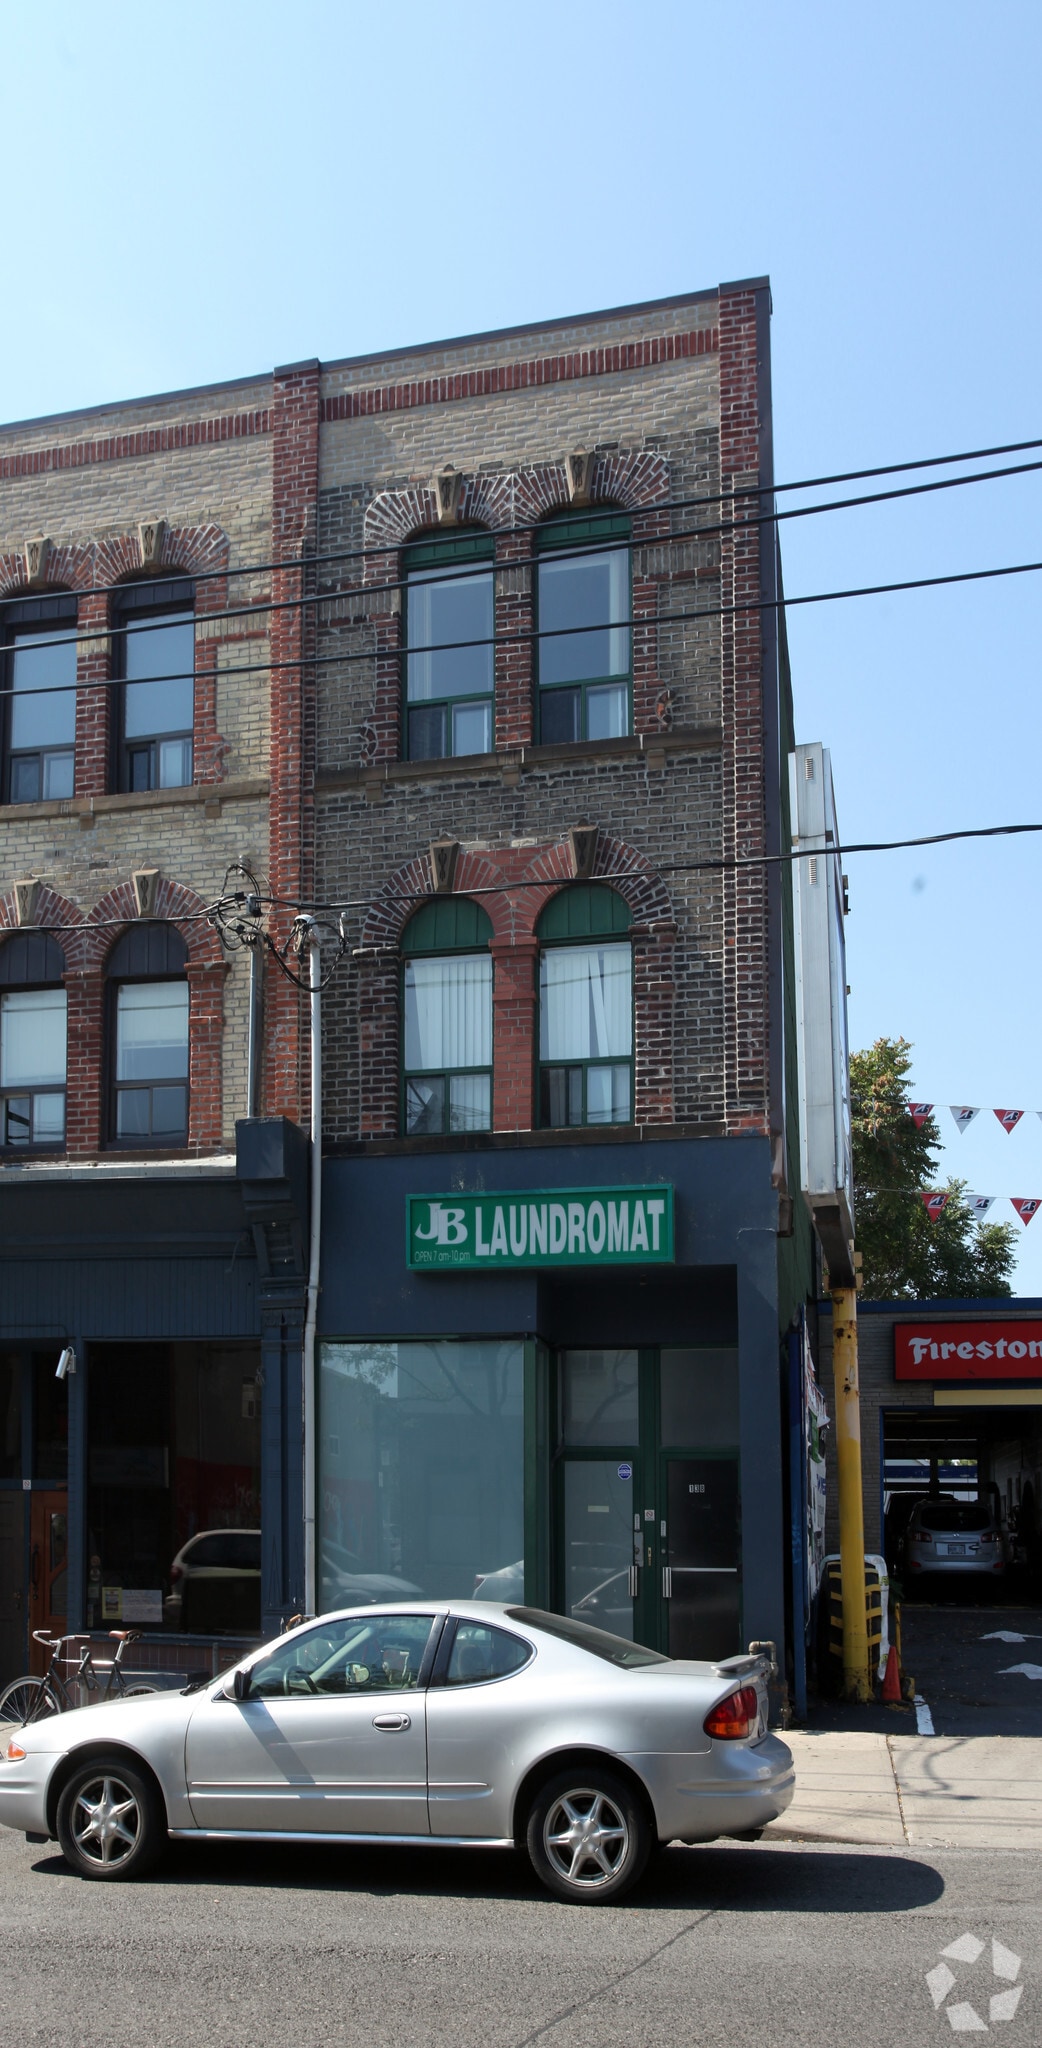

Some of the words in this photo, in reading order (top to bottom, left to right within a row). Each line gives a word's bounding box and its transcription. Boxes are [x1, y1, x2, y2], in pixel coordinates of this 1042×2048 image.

[414, 1203, 468, 1245] JB
[474, 1199, 665, 1257] LAUNDROMAT
[414, 1250, 432, 1262] OPEN
